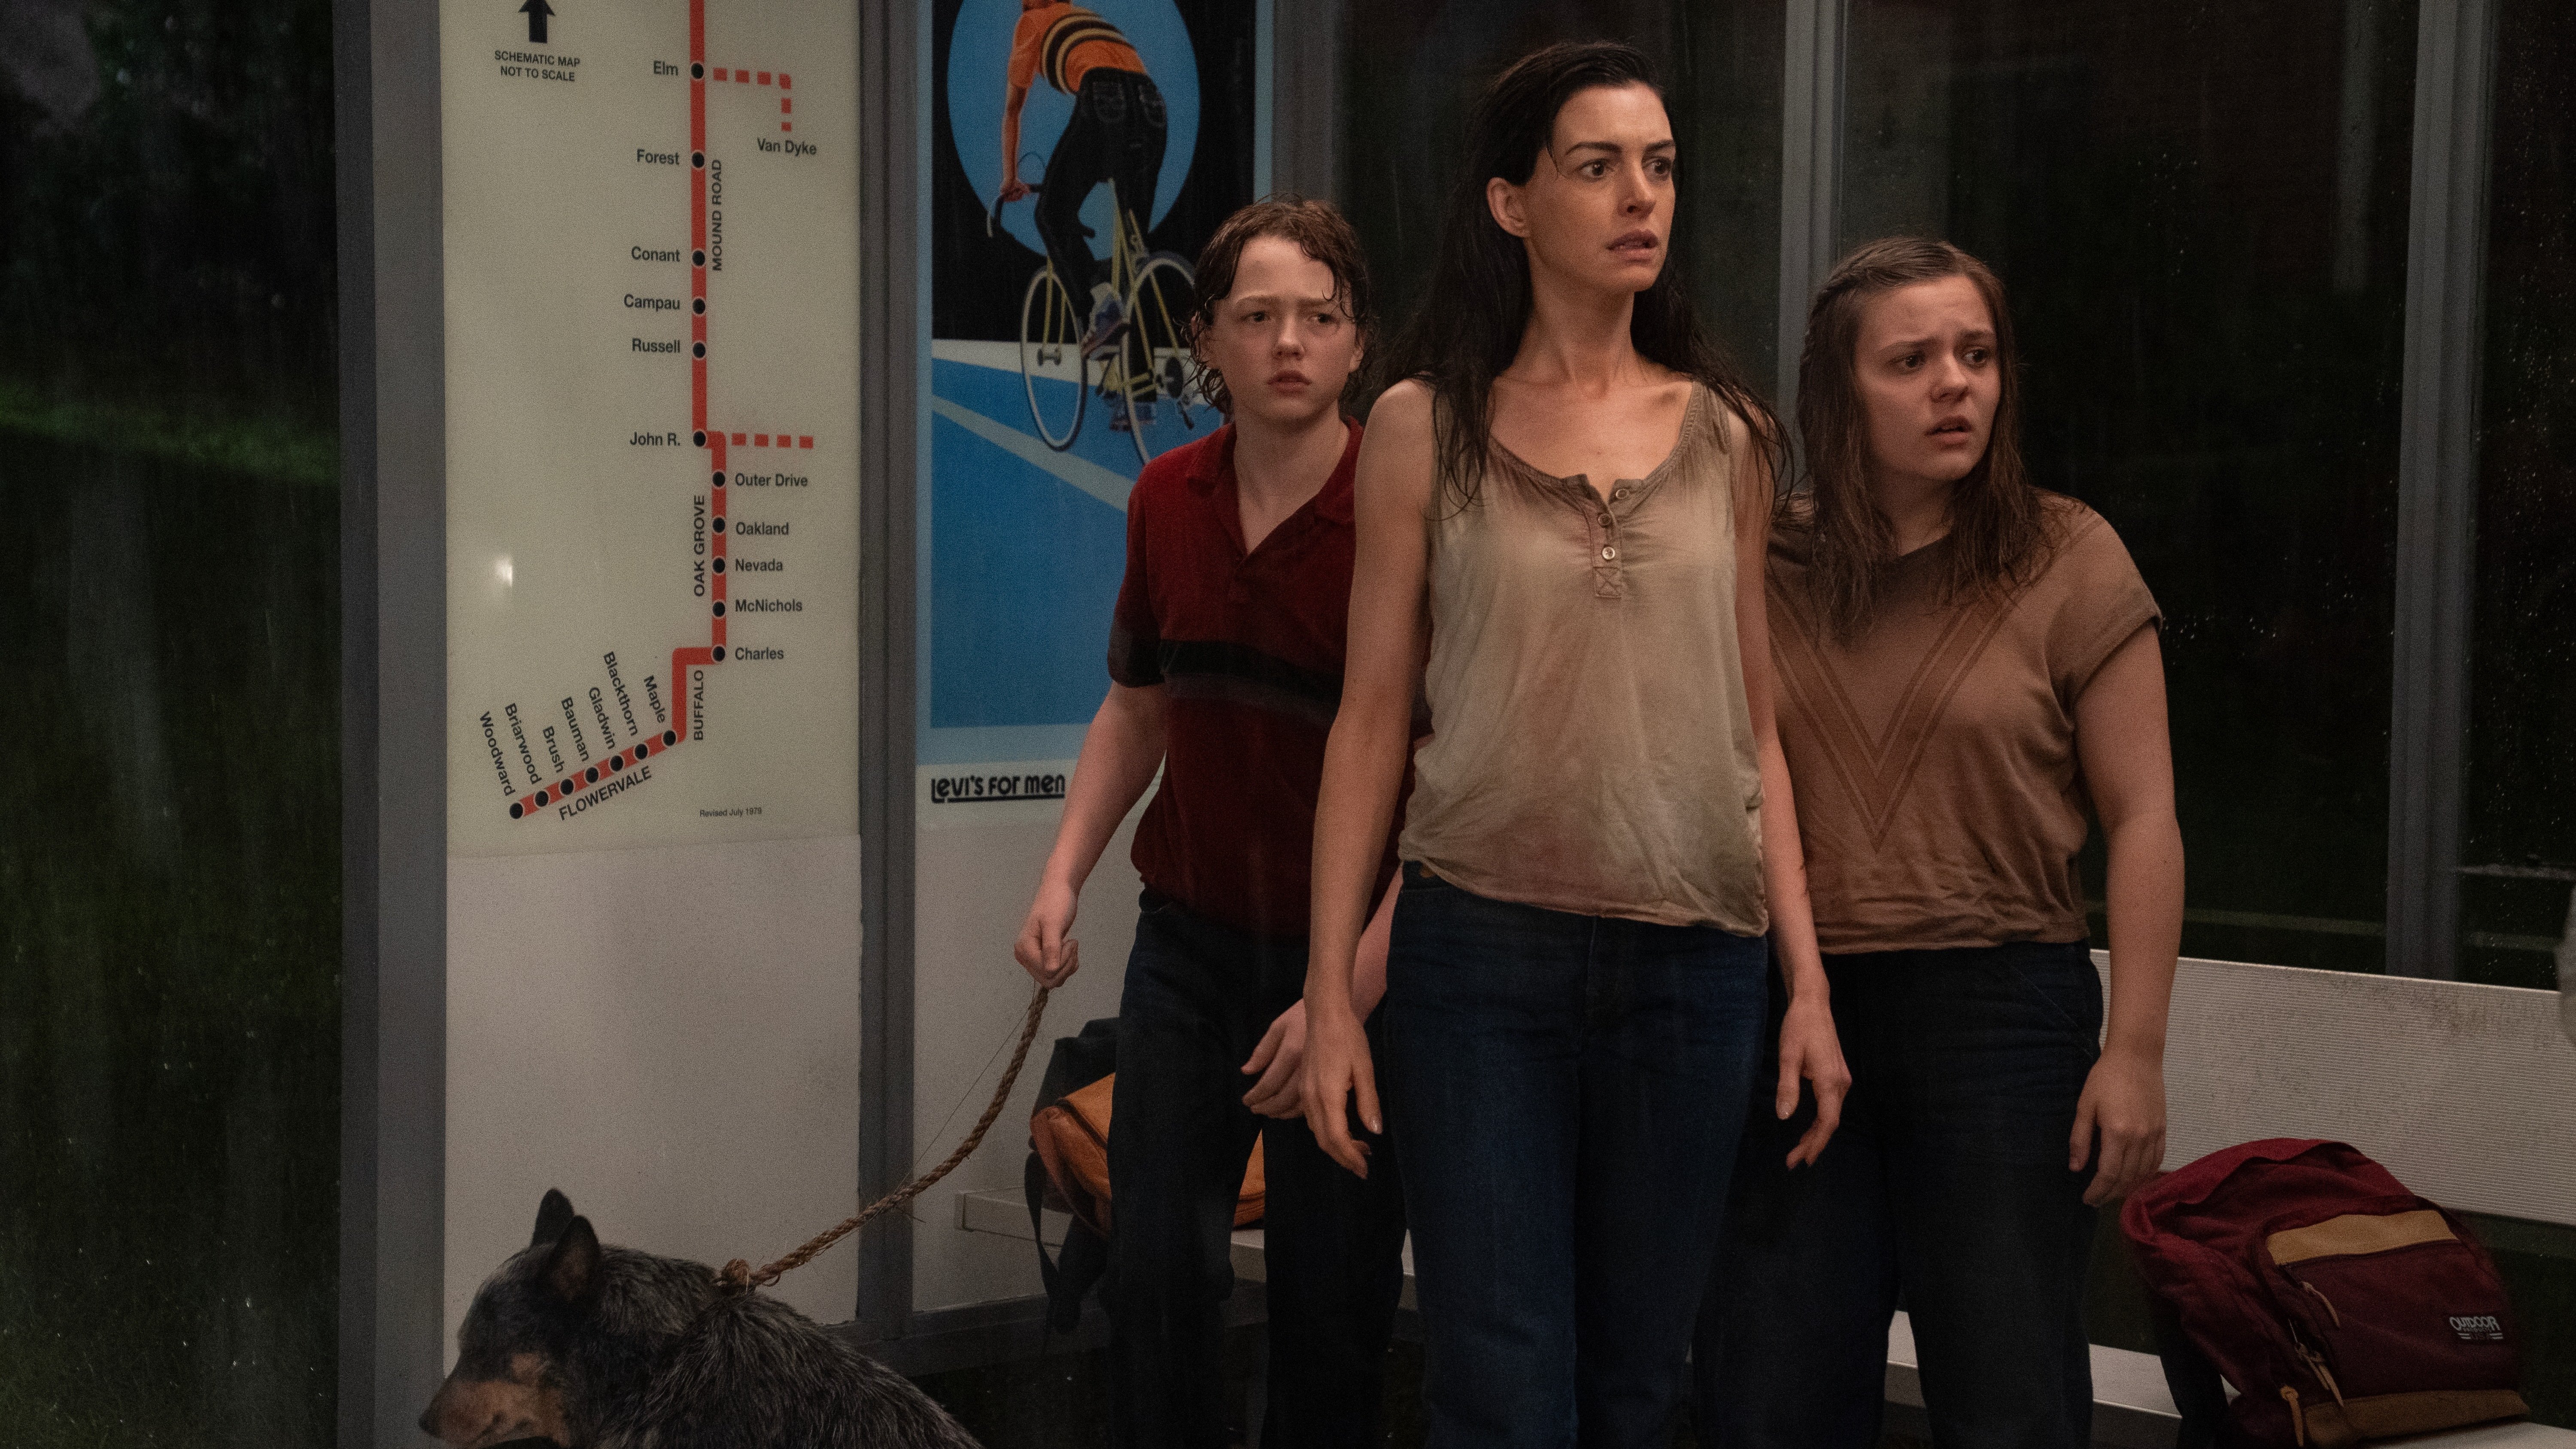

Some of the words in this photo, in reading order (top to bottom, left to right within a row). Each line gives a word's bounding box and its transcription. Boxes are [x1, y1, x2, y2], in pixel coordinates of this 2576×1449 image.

[495, 50, 555, 66] SCHEMATIC
[557, 56, 580, 67] MAP
[653, 60, 679, 76] Elm
[500, 65, 522, 77] NOT
[525, 67, 539, 79] TO
[541, 69, 575, 82] SCALE
[637, 148, 680, 166] Forest
[757, 138, 781, 152] Van
[784, 140, 817, 157] Dyke
[711, 159, 722, 206] ROAD
[711, 210, 722, 271] MOUND
[631, 246, 680, 262] Conant
[623, 293, 680, 312] Campau
[632, 337, 681, 353] Russell
[629, 432, 663, 446] John
[667, 432, 680, 446] R.
[735, 472, 772, 487] Outer
[775, 473, 808, 487] Drive
[693, 495, 705, 556] GROVE
[735, 521, 790, 536] Oakland
[735, 558, 783, 572] Nevada
[694, 560, 705, 597] OAK
[735, 599, 803, 612] McNichols
[735, 647, 784, 661] Charles
[603, 651, 639, 737] Blackthorn
[644, 675, 665, 723] Maple
[693, 670, 704, 741] BUFFALO
[589, 686, 616, 750] Gladwin
[561, 696, 589, 762] Bauman
[504, 703, 543, 785] Briarwood
[542, 726, 565, 773] Brush
[480, 711, 516, 797] Woodward
[558, 765, 652, 820] FLOWERVALE
[699, 809, 728, 817] Revised
[729, 808, 744, 817] July
[745, 807, 762, 815] 1979
[2449, 1316, 2500, 1331] OUTDOOR
